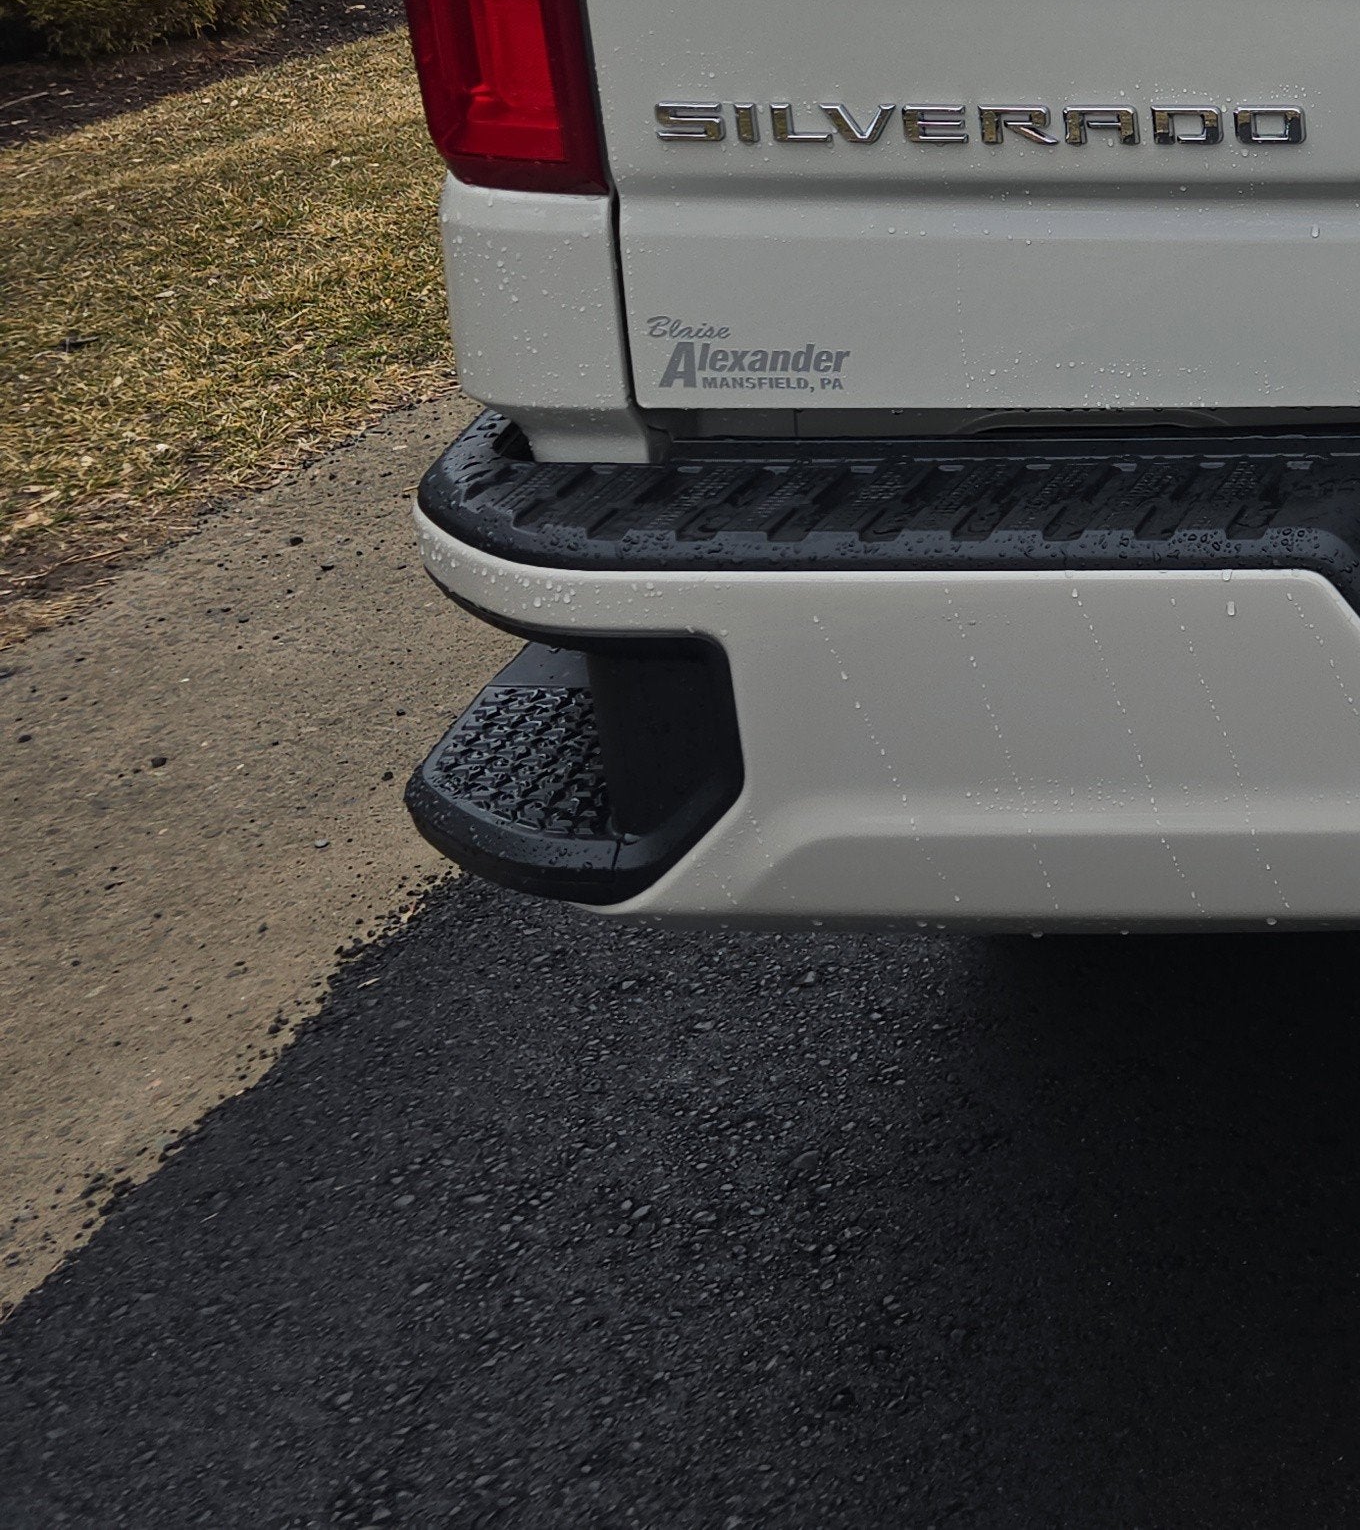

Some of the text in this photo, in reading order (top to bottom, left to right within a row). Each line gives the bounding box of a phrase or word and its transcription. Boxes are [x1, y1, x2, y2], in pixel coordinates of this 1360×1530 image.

[654, 101, 1306, 145] SILVERADO
[647, 315, 731, 339] Blaise
[658, 341, 851, 388] Alexander
[702, 376, 844, 393] MANSFIELD, PA
